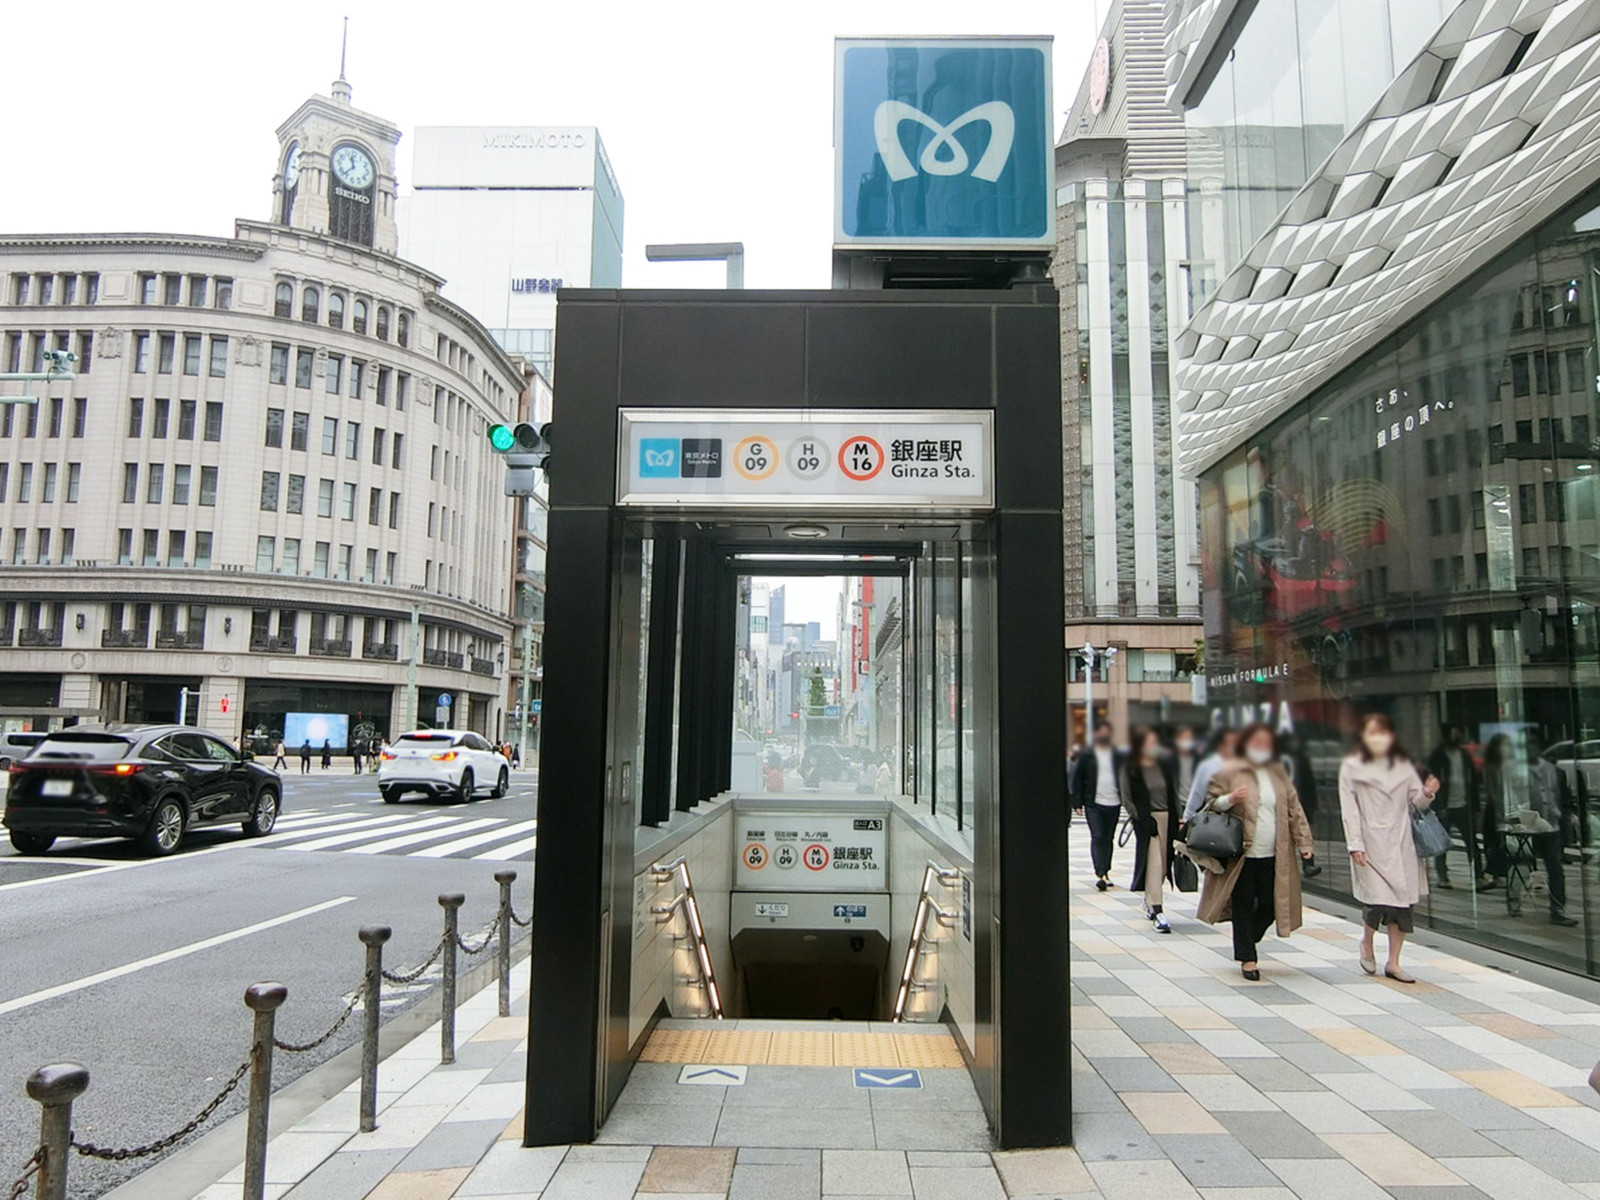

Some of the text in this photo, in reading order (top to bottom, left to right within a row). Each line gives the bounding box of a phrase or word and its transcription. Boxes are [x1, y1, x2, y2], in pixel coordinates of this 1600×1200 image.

[483, 134, 586, 148] MIKIMOTO
[335, 187, 370, 205] SEIKO
[1375, 389, 1408, 413] さあ、
[750, 443, 762, 456] G
[803, 443, 814, 455] H
[854, 443, 868, 456] M
[891, 439, 963, 462] 銀座駅
[745, 457, 767, 471] 09
[797, 457, 819, 471] 09
[852, 457, 872, 471] 16
[891, 464, 975, 478] Ginza Sta.
[1210, 663, 1289, 687] NISSAN FORMULA E
[867, 820, 881, 829] A3
[749, 856, 762, 864] 09
[833, 846, 873, 860] 銀座駅
[811, 857, 822, 865] 16
[833, 860, 880, 870] Ginza Sta.
